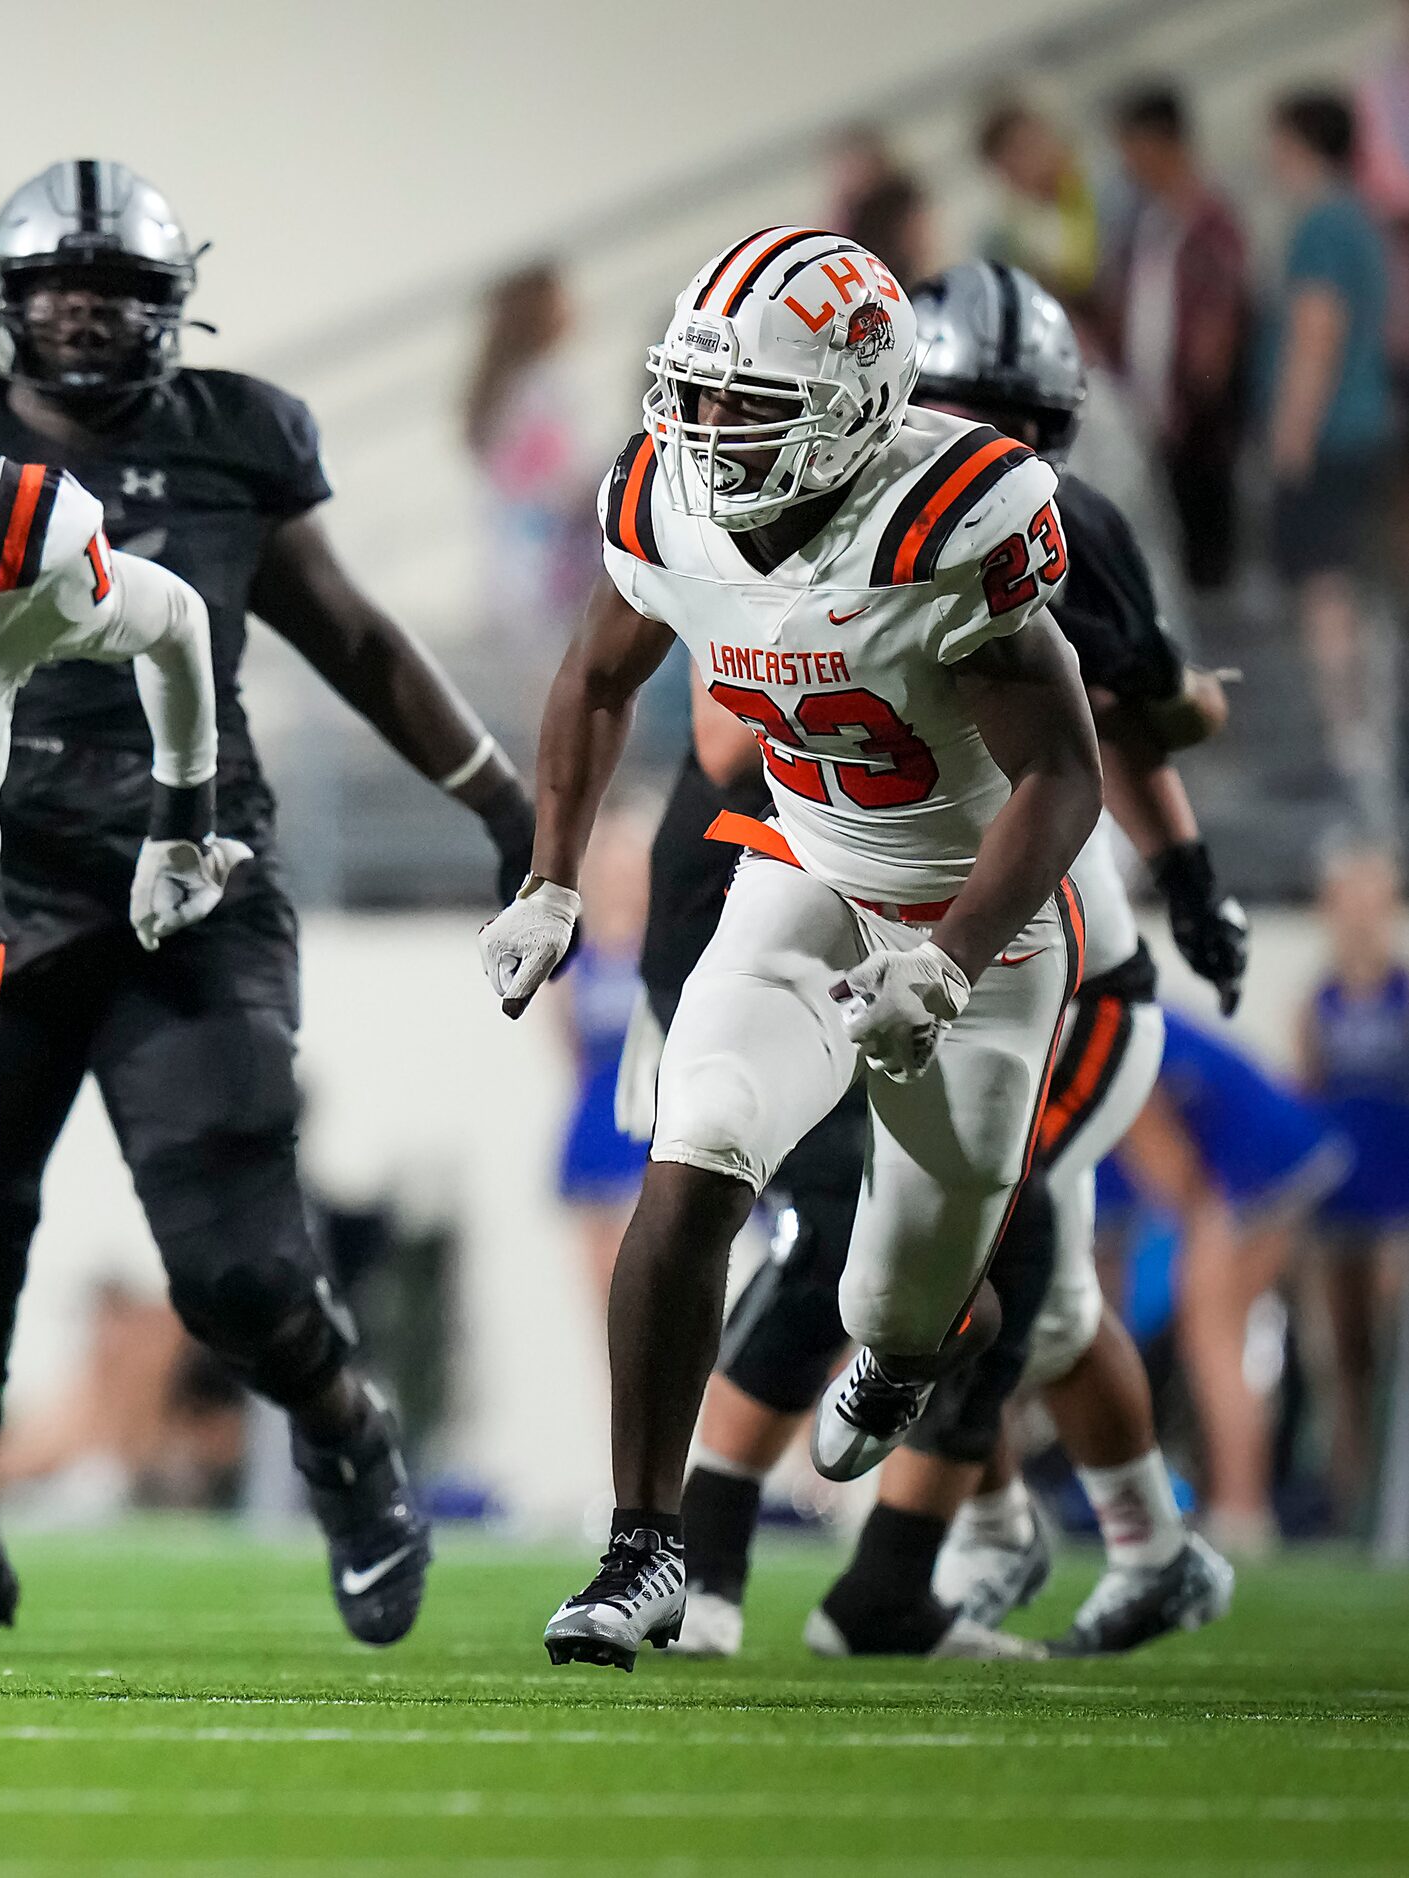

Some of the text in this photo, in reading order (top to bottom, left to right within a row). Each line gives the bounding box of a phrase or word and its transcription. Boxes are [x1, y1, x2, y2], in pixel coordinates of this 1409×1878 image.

[686, 333, 717, 348] schutt
[980, 499, 1067, 619] 23
[709, 640, 851, 686] LANCASTER
[707, 679, 941, 810] 23
